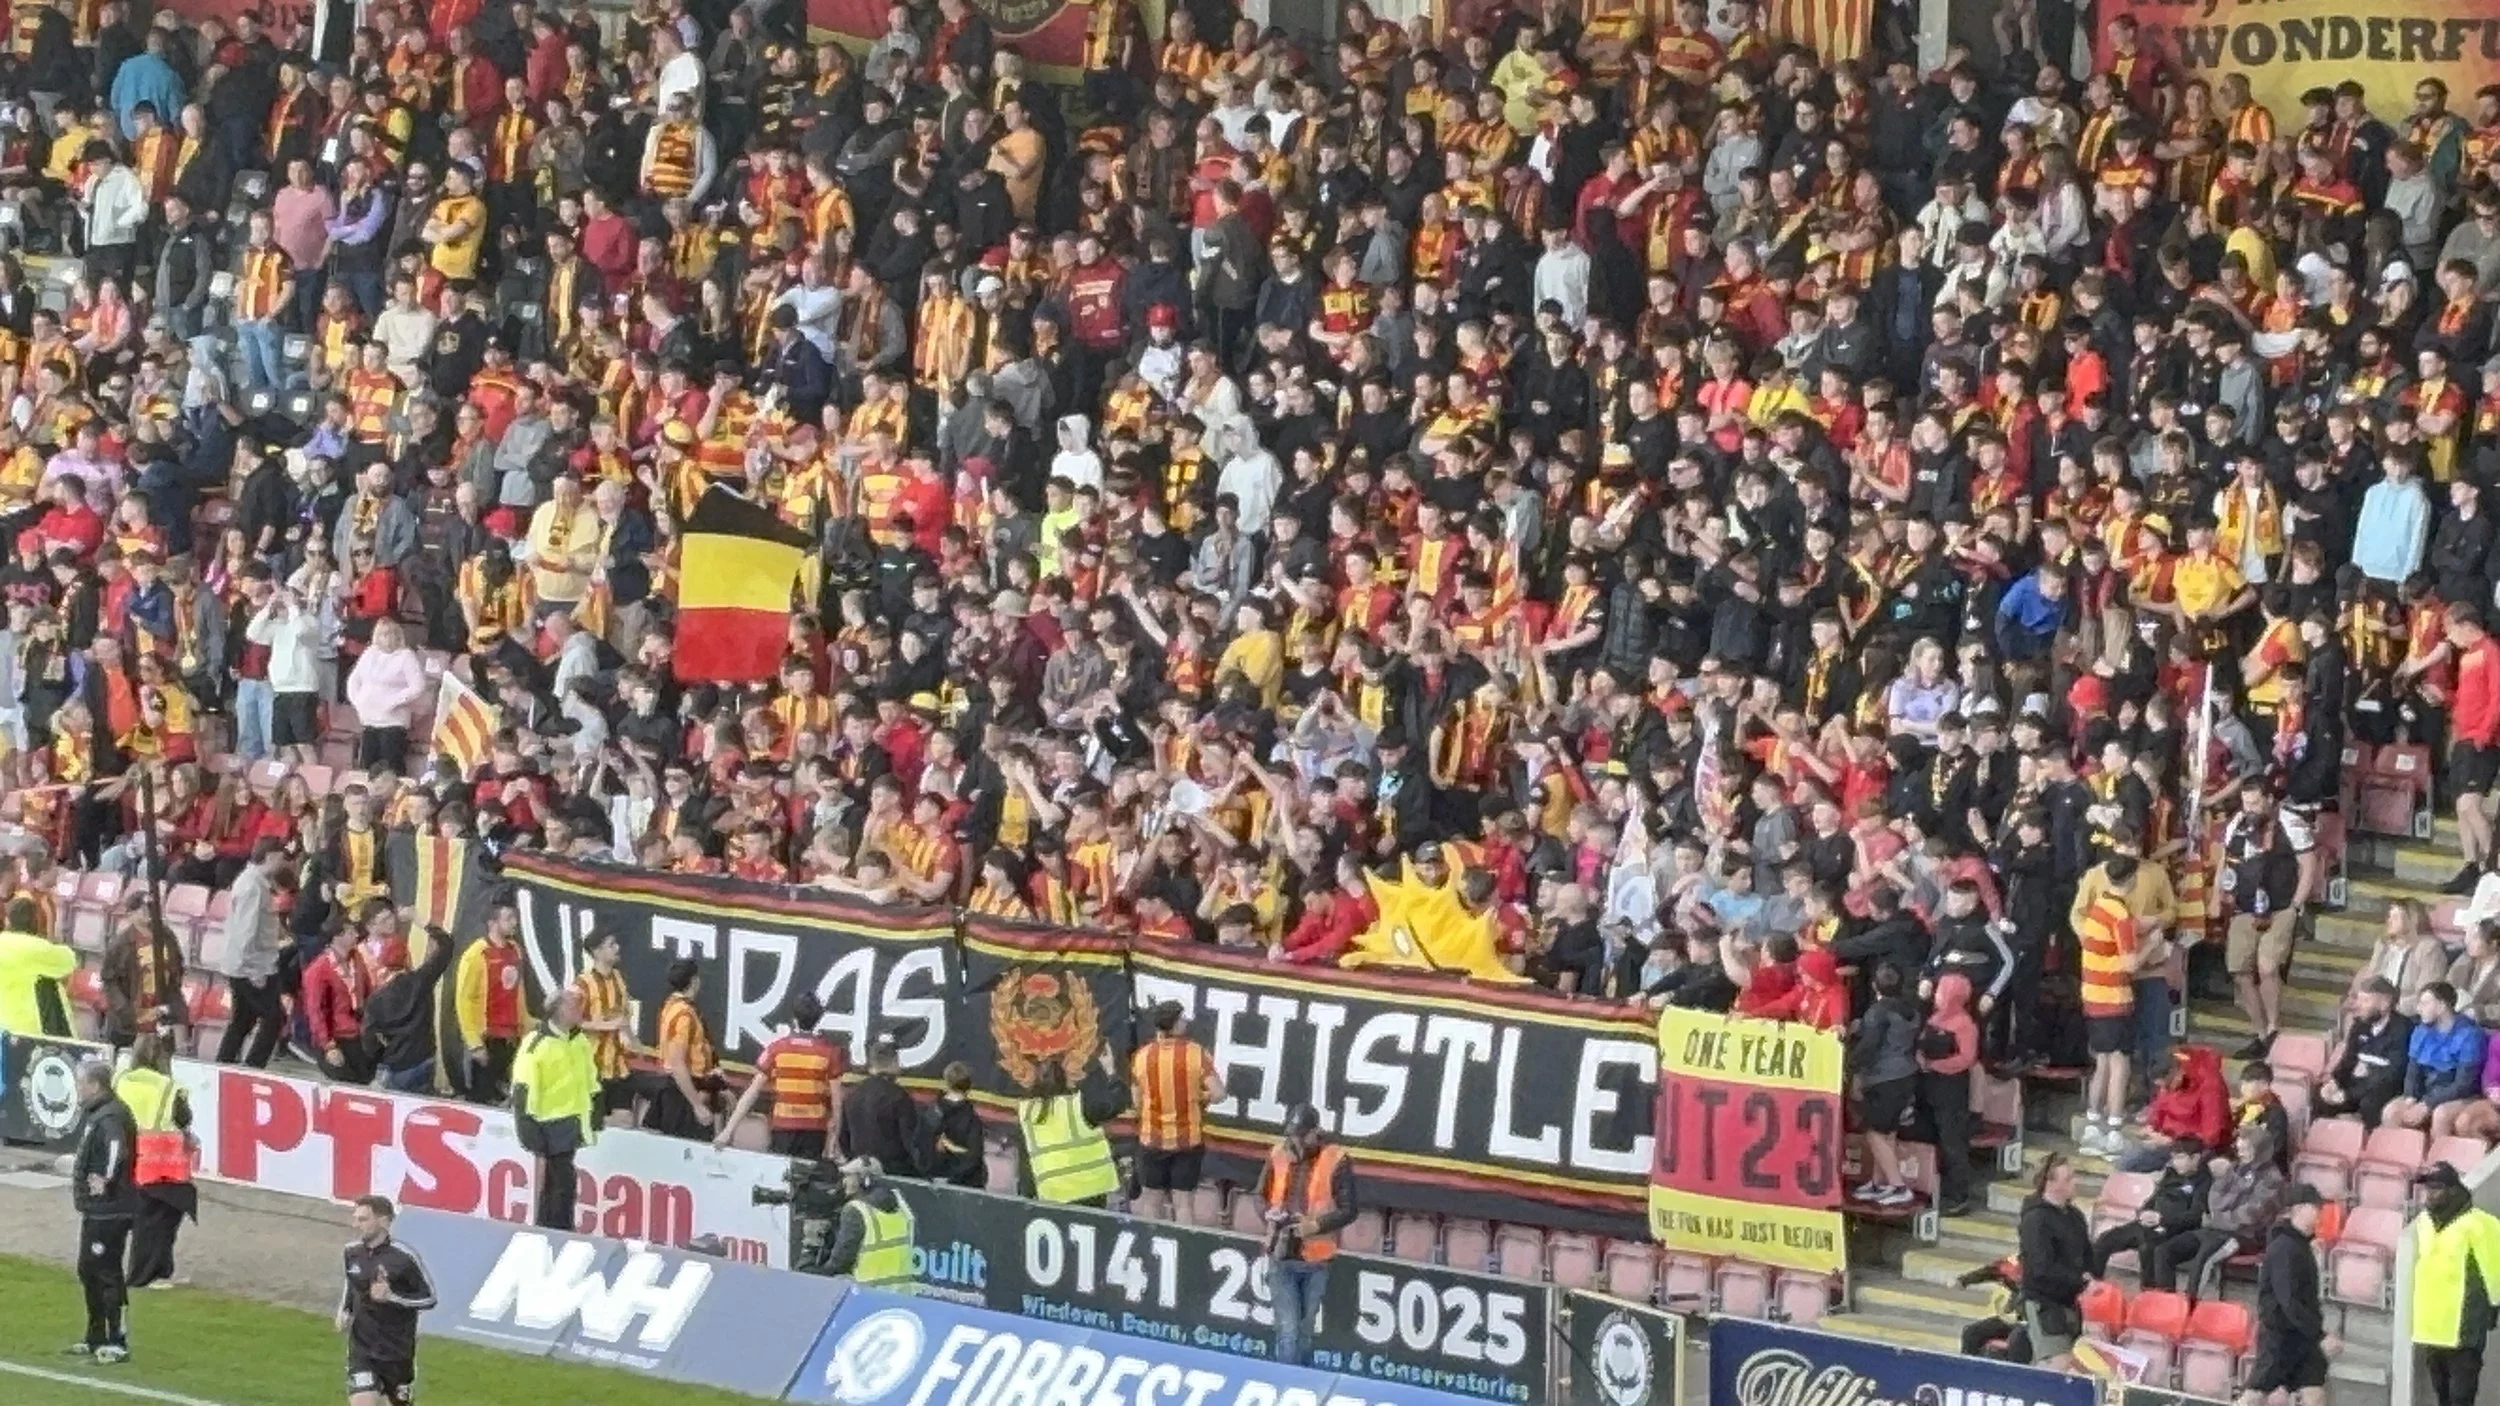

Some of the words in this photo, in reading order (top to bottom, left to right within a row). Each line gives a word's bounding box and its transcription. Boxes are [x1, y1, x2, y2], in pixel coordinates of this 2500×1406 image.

[1682, 1028, 1731, 1071] ONE
[1740, 1034, 1807, 1080] YEAR
[487, 1158, 693, 1249] cean
[1706, 1216, 1734, 1240] HAS
[1740, 1220, 1778, 1244] JUST
[470, 1232, 714, 1352] NWH
[1024, 1218, 1179, 1309] 0141
[1209, 1248, 1322, 1333] 29
[1355, 1271, 1527, 1366] 5025
[1193, 1325, 1266, 1356] Garden
[1369, 1354, 1530, 1402] Conservatories
